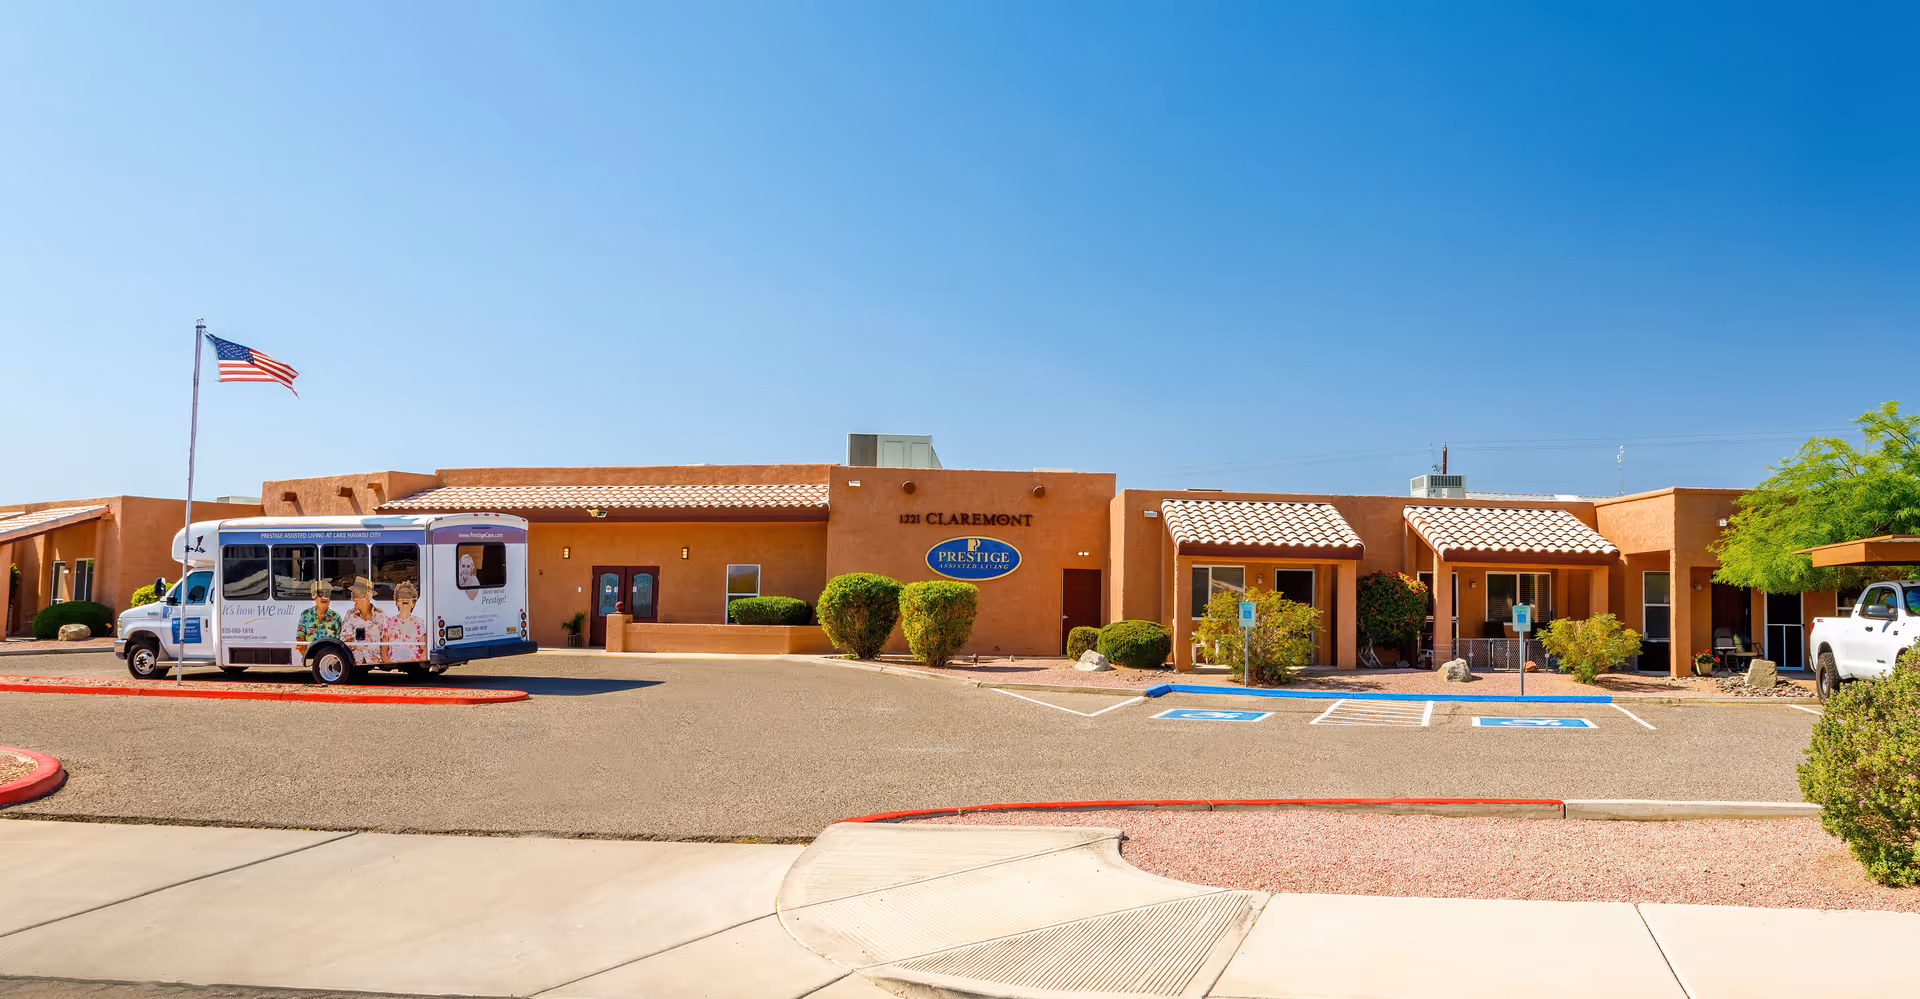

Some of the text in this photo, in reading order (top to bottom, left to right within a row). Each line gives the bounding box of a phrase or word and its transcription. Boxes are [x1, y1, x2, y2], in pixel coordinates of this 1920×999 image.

[899, 512, 1033, 527] 1221 CLAREMONT
[938, 551, 1010, 563] PRESTIGE
[222, 605, 235, 616] It's
[236, 604, 256, 616] how
[276, 605, 296, 616] roll!
